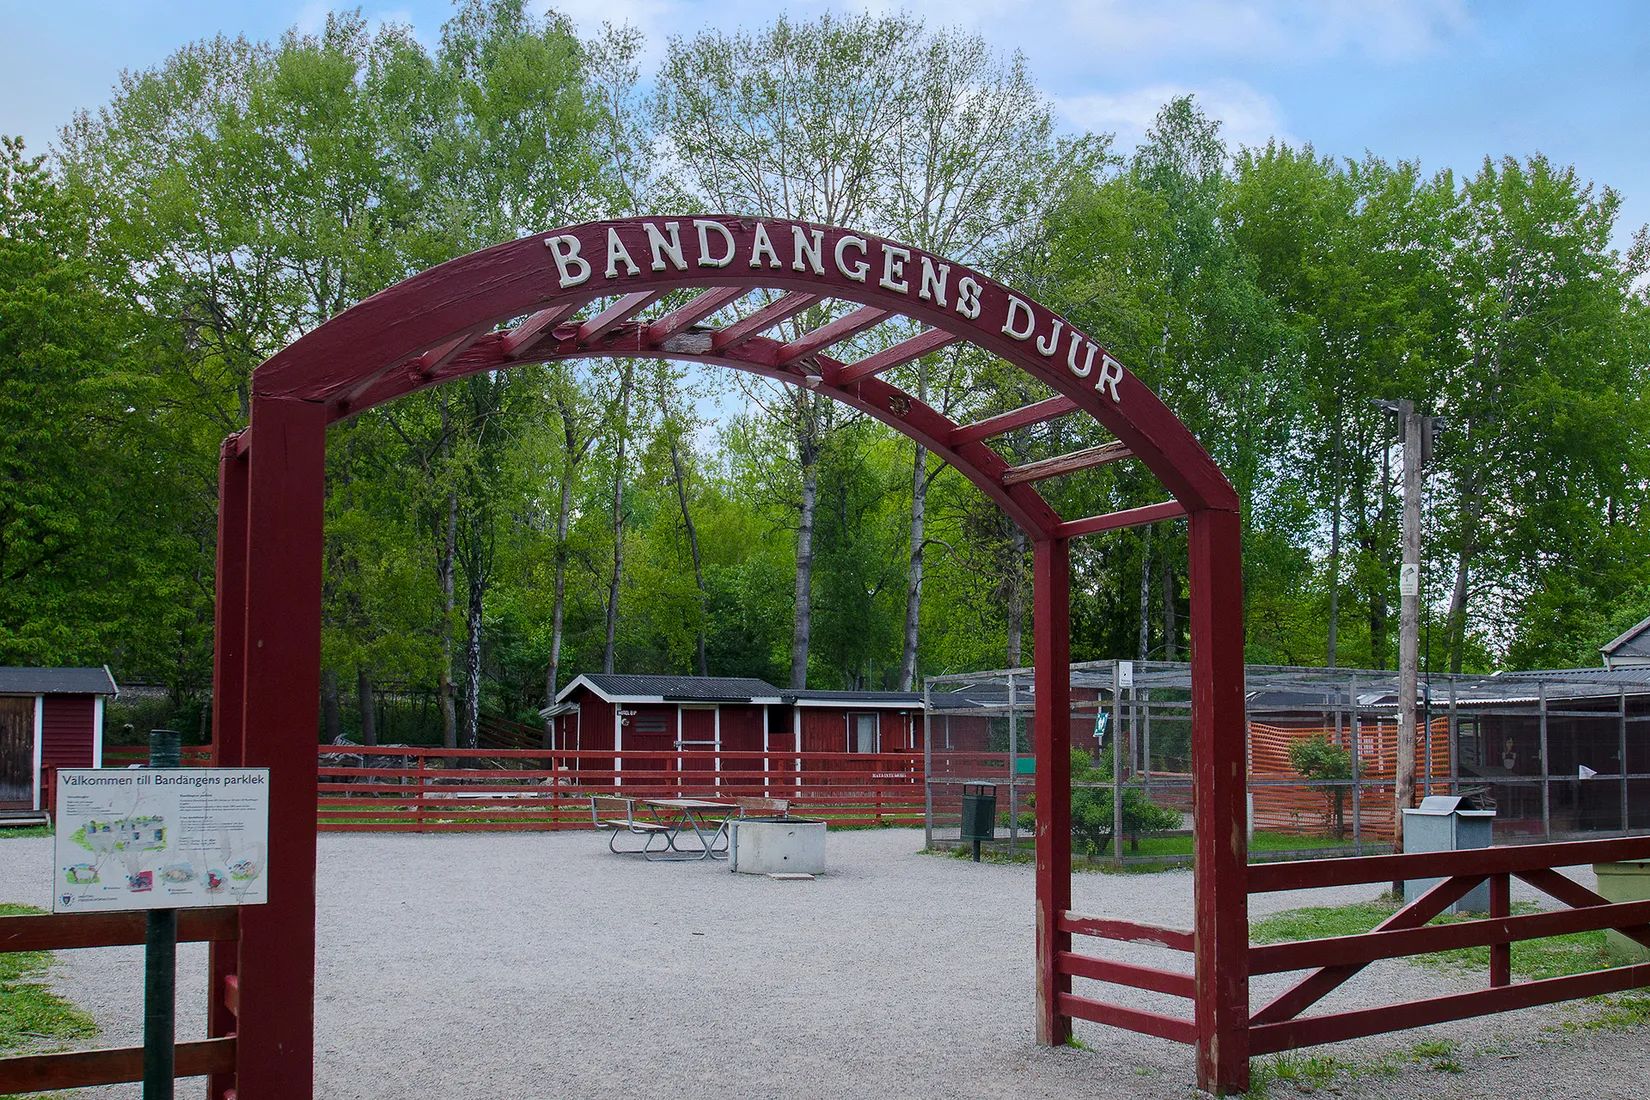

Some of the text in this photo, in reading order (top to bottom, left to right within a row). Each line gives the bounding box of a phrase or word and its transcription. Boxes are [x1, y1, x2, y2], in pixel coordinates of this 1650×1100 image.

[543, 219, 1124, 403] BANDANGENS DJUR
[62, 774, 265, 788] Välkommen till Bandängens parklek
